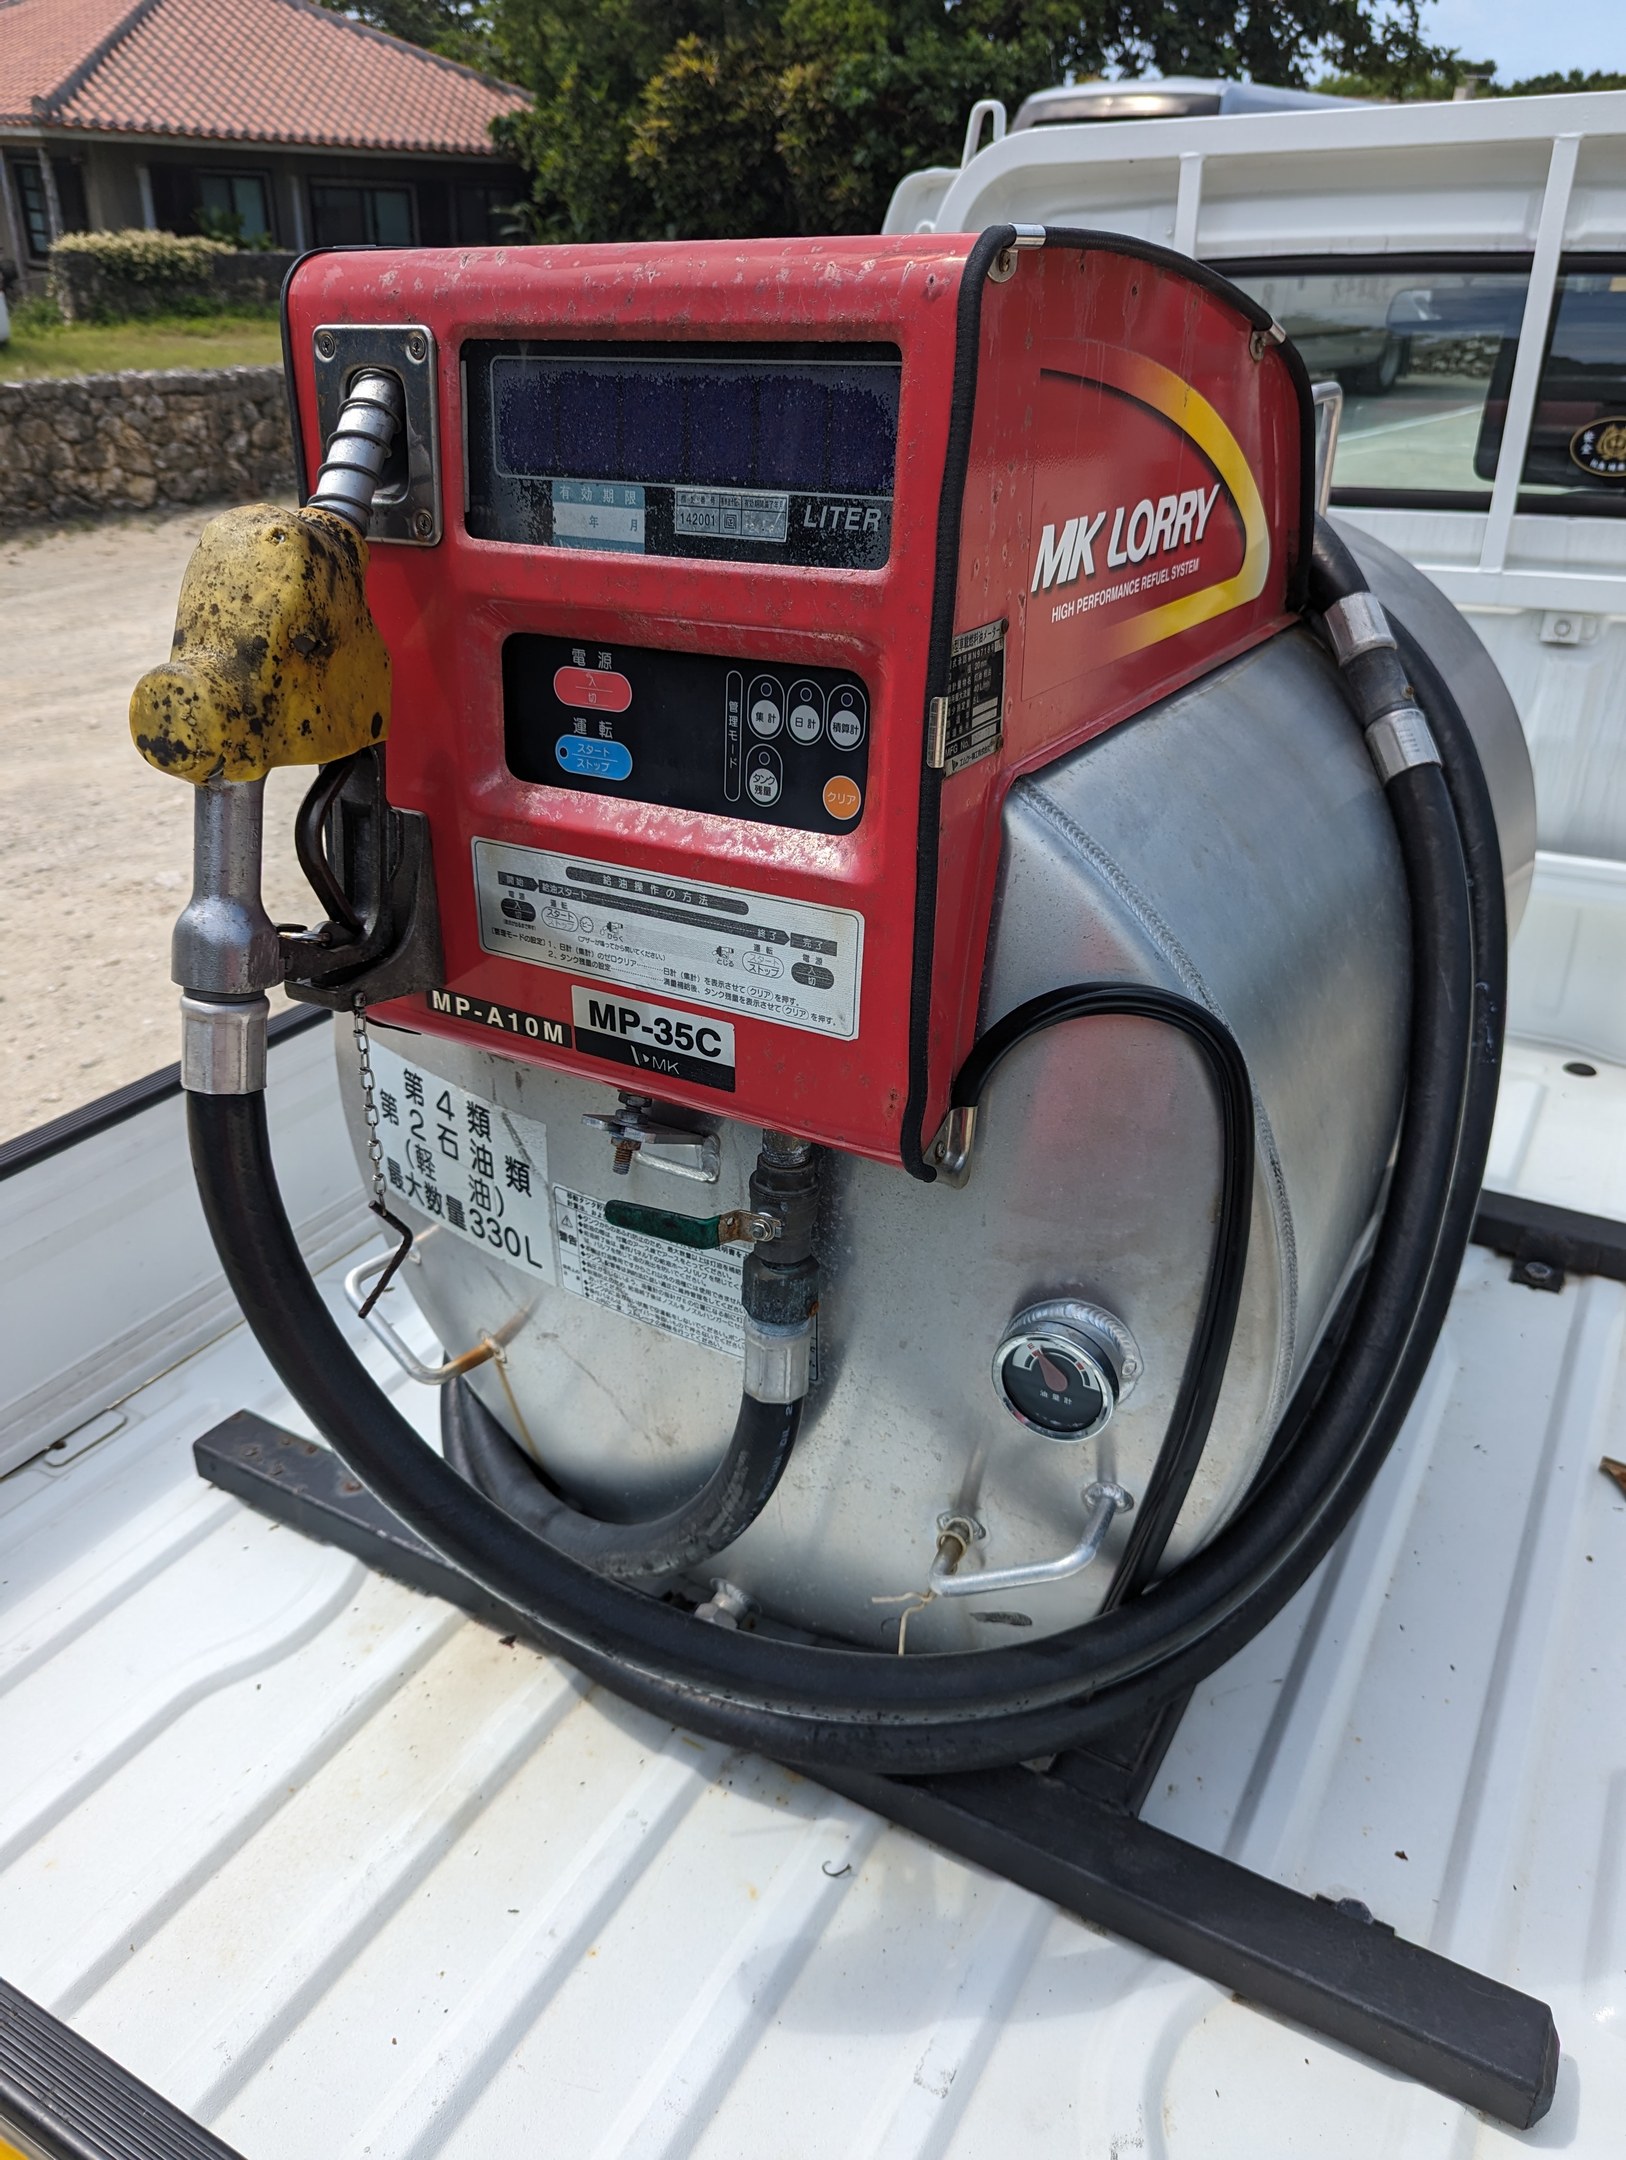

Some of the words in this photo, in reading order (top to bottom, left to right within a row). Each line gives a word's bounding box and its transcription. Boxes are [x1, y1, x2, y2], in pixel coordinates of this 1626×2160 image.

[559, 485, 637, 506] 有効期限
[588, 515, 599, 529] 年
[629, 519, 638, 533] 月
[680, 513, 716, 527] 142001
[803, 504, 882, 532] LITER
[1031, 511, 1107, 593] MK
[1107, 483, 1221, 569] LORRY
[1051, 600, 1075, 624] HIGH
[1076, 577, 1140, 616] PERFORMANCE
[1141, 570, 1170, 590] REFUEL
[1171, 557, 1200, 580] SYSTEM
[571, 648, 613, 670] 電源
[587, 674, 597, 687] 入
[588, 693, 597, 704] 切
[755, 711, 777, 724] 集計
[794, 716, 817, 730] 日計
[573, 717, 613, 740] 運転
[727, 700, 739, 769] 管理モード
[832, 721, 860, 736] 積算計
[577, 743, 610, 757] スタート
[576, 758, 610, 772] ストップ
[752, 773, 775, 786] タンク
[754, 785, 772, 797] 残量
[827, 791, 857, 805] クリア
[602, 874, 709, 906] 給油操作の方法
[541, 882, 588, 900] 給油スタート
[757, 928, 776, 940] 終了
[547, 908, 574, 920] スタート
[548, 920, 574, 931] ストップ
[753, 943, 774, 955] 運転
[802, 938, 823, 950] 完了
[716, 957, 734, 968] とじる
[750, 954, 780, 966] スタート
[802, 953, 823, 965] 電源
[749, 964, 780, 977] ストップ
[432, 989, 564, 1045] MP-A10M
[589, 999, 722, 1058] MP-35C
[651, 1057, 680, 1075] MK
[404, 1068, 492, 1143] 第4類
[380, 1088, 532, 1198] 第2石油類
[387, 1156, 543, 1269] 最大数量330L
[1039, 1389, 1073, 1405] 油量計
